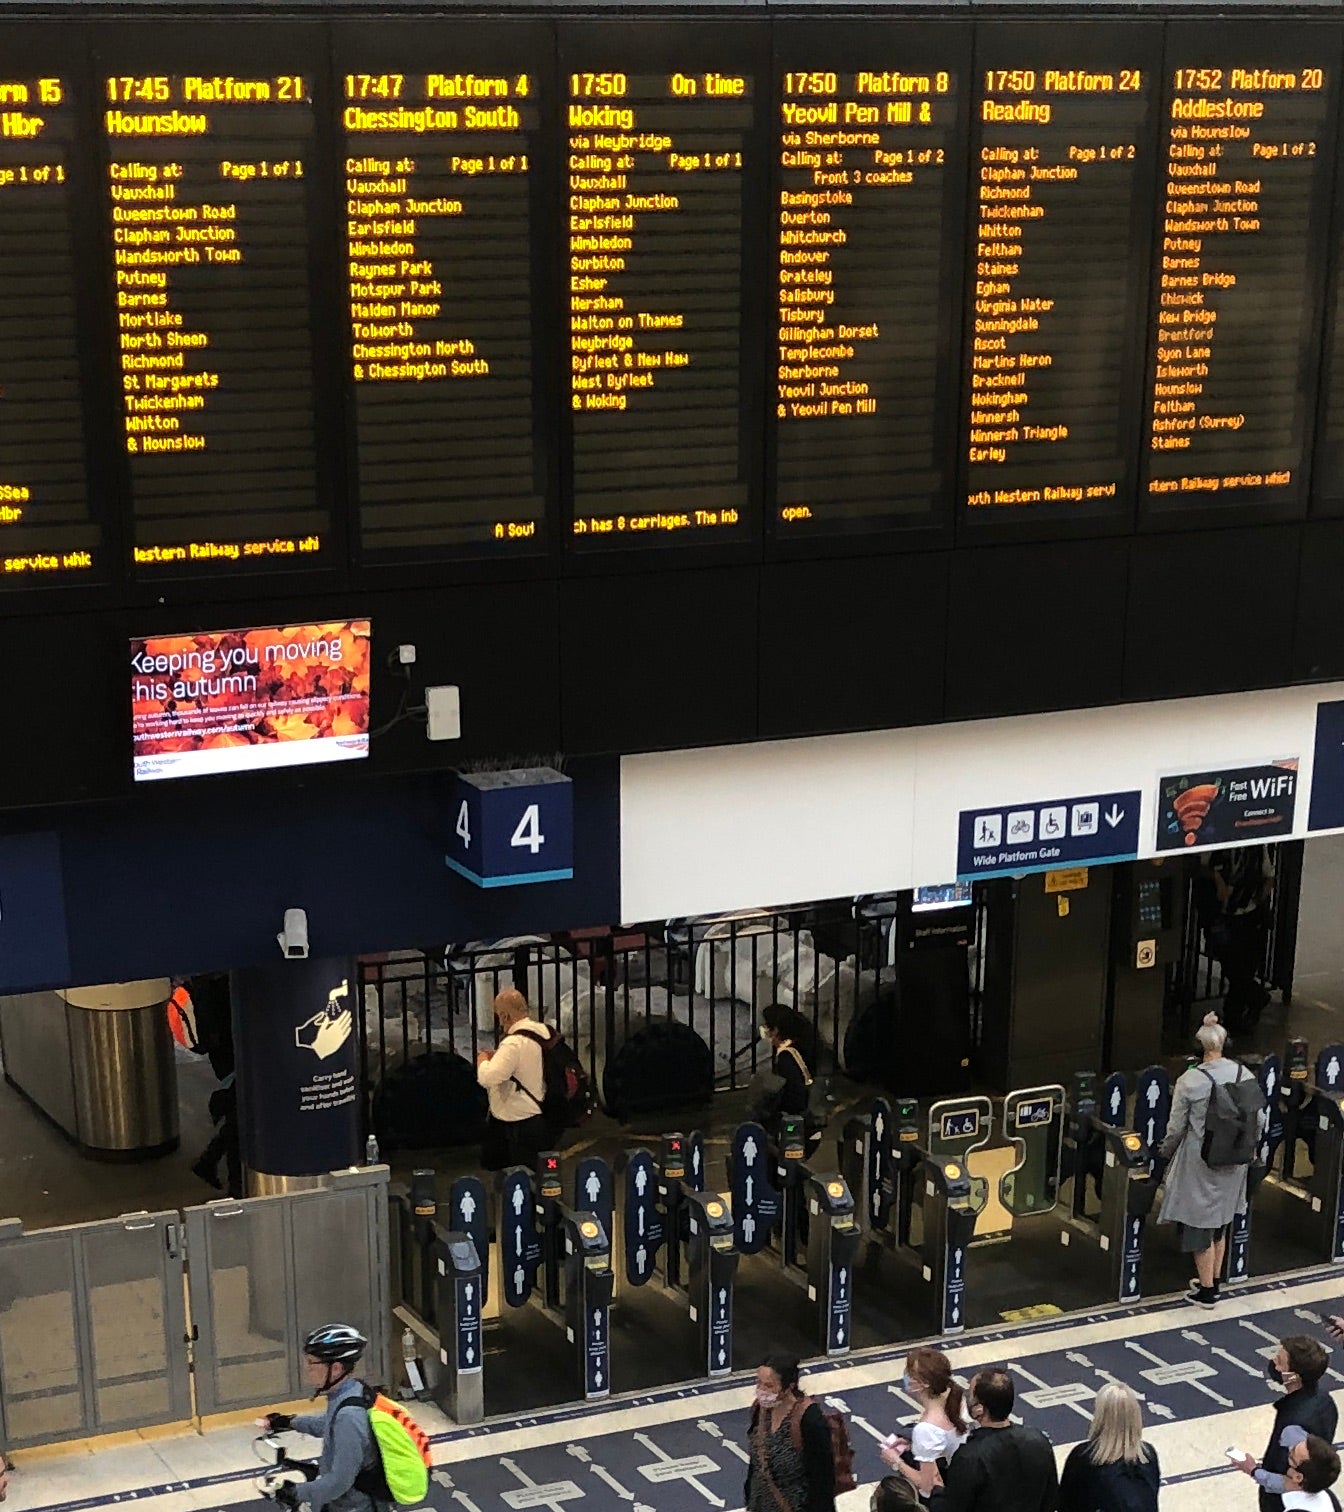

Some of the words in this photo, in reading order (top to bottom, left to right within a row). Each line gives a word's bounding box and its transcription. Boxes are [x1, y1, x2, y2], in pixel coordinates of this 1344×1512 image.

[38, 78, 62, 103] 15
[107, 76, 170, 102] 17:45
[184, 76, 271, 102] Platform
[276, 76, 302, 100] 21
[346, 74, 404, 98] 17:47
[428, 74, 509, 98] Platform
[515, 74, 529, 96] 4
[572, 73, 627, 97] 17:50
[672, 73, 697, 95] On
[705, 73, 745, 96] time
[786, 72, 837, 94] 17:50
[859, 71, 930, 94] Platform
[936, 71, 949, 93] 8
[987, 70, 1035, 93] 17:50
[1045, 70, 1114, 91] Platform
[1119, 70, 1141, 91] 24
[1176, 68, 1223, 90] 17:52
[1231, 68, 1297, 91] Platform
[1301, 68, 1323, 89] 20
[344, 106, 459, 133] Chessington
[465, 105, 520, 129] South
[569, 104, 634, 130] Woking
[783, 102, 838, 125] Yeovil
[845, 102, 880, 123] Pen
[887, 101, 913, 123] Mill
[919, 101, 932, 123] &
[983, 99, 1051, 124] Reading
[1172, 97, 1264, 119] Addlestone
[1, 112, 45, 137] Hbr
[105, 109, 207, 135] Hounslow
[977, 261, 1019, 276] Staines
[571, 276, 608, 291] Esher
[780, 307, 825, 324] Tisbury
[353, 321, 414, 338] Tolworth
[1157, 363, 1209, 378] Isleworth
[125, 414, 180, 432] Whitton
[219, 647, 258, 672] you
[265, 637, 343, 662] moving
[172, 675, 257, 699] autumn
[1228, 792, 1248, 802] Free
[1229, 781, 1248, 791] Fast
[1250, 775, 1294, 799] WiFi
[456, 800, 471, 849] 4
[1243, 809, 1267, 817] Connect
[510, 804, 545, 854] 4
[973, 855, 997, 866] Wide
[998, 851, 1037, 863] Platform
[1039, 847, 1061, 858] Gate
